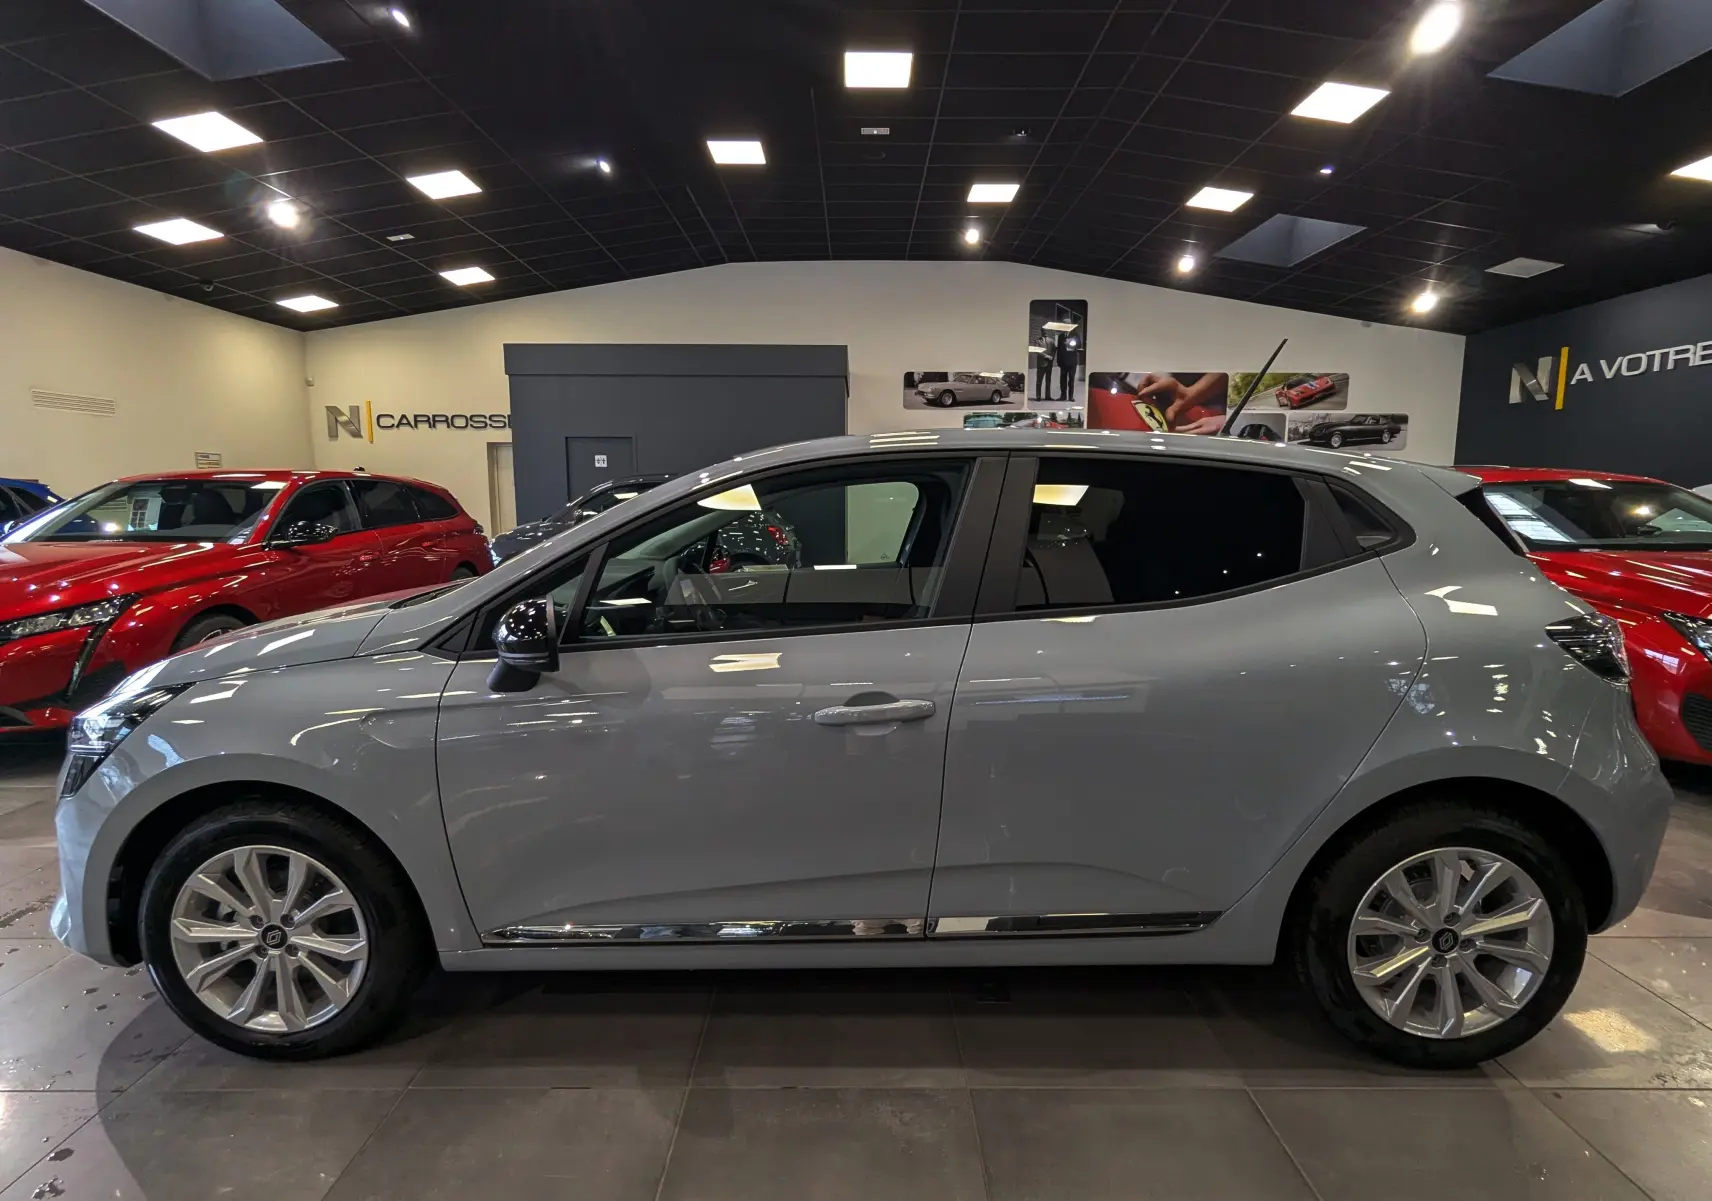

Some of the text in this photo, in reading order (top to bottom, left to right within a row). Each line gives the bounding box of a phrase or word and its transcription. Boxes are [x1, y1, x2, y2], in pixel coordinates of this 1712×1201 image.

[1570, 363, 1594, 385] A
[1600, 340, 1712, 379] VOTRE
[376, 413, 511, 429] CARROSS
